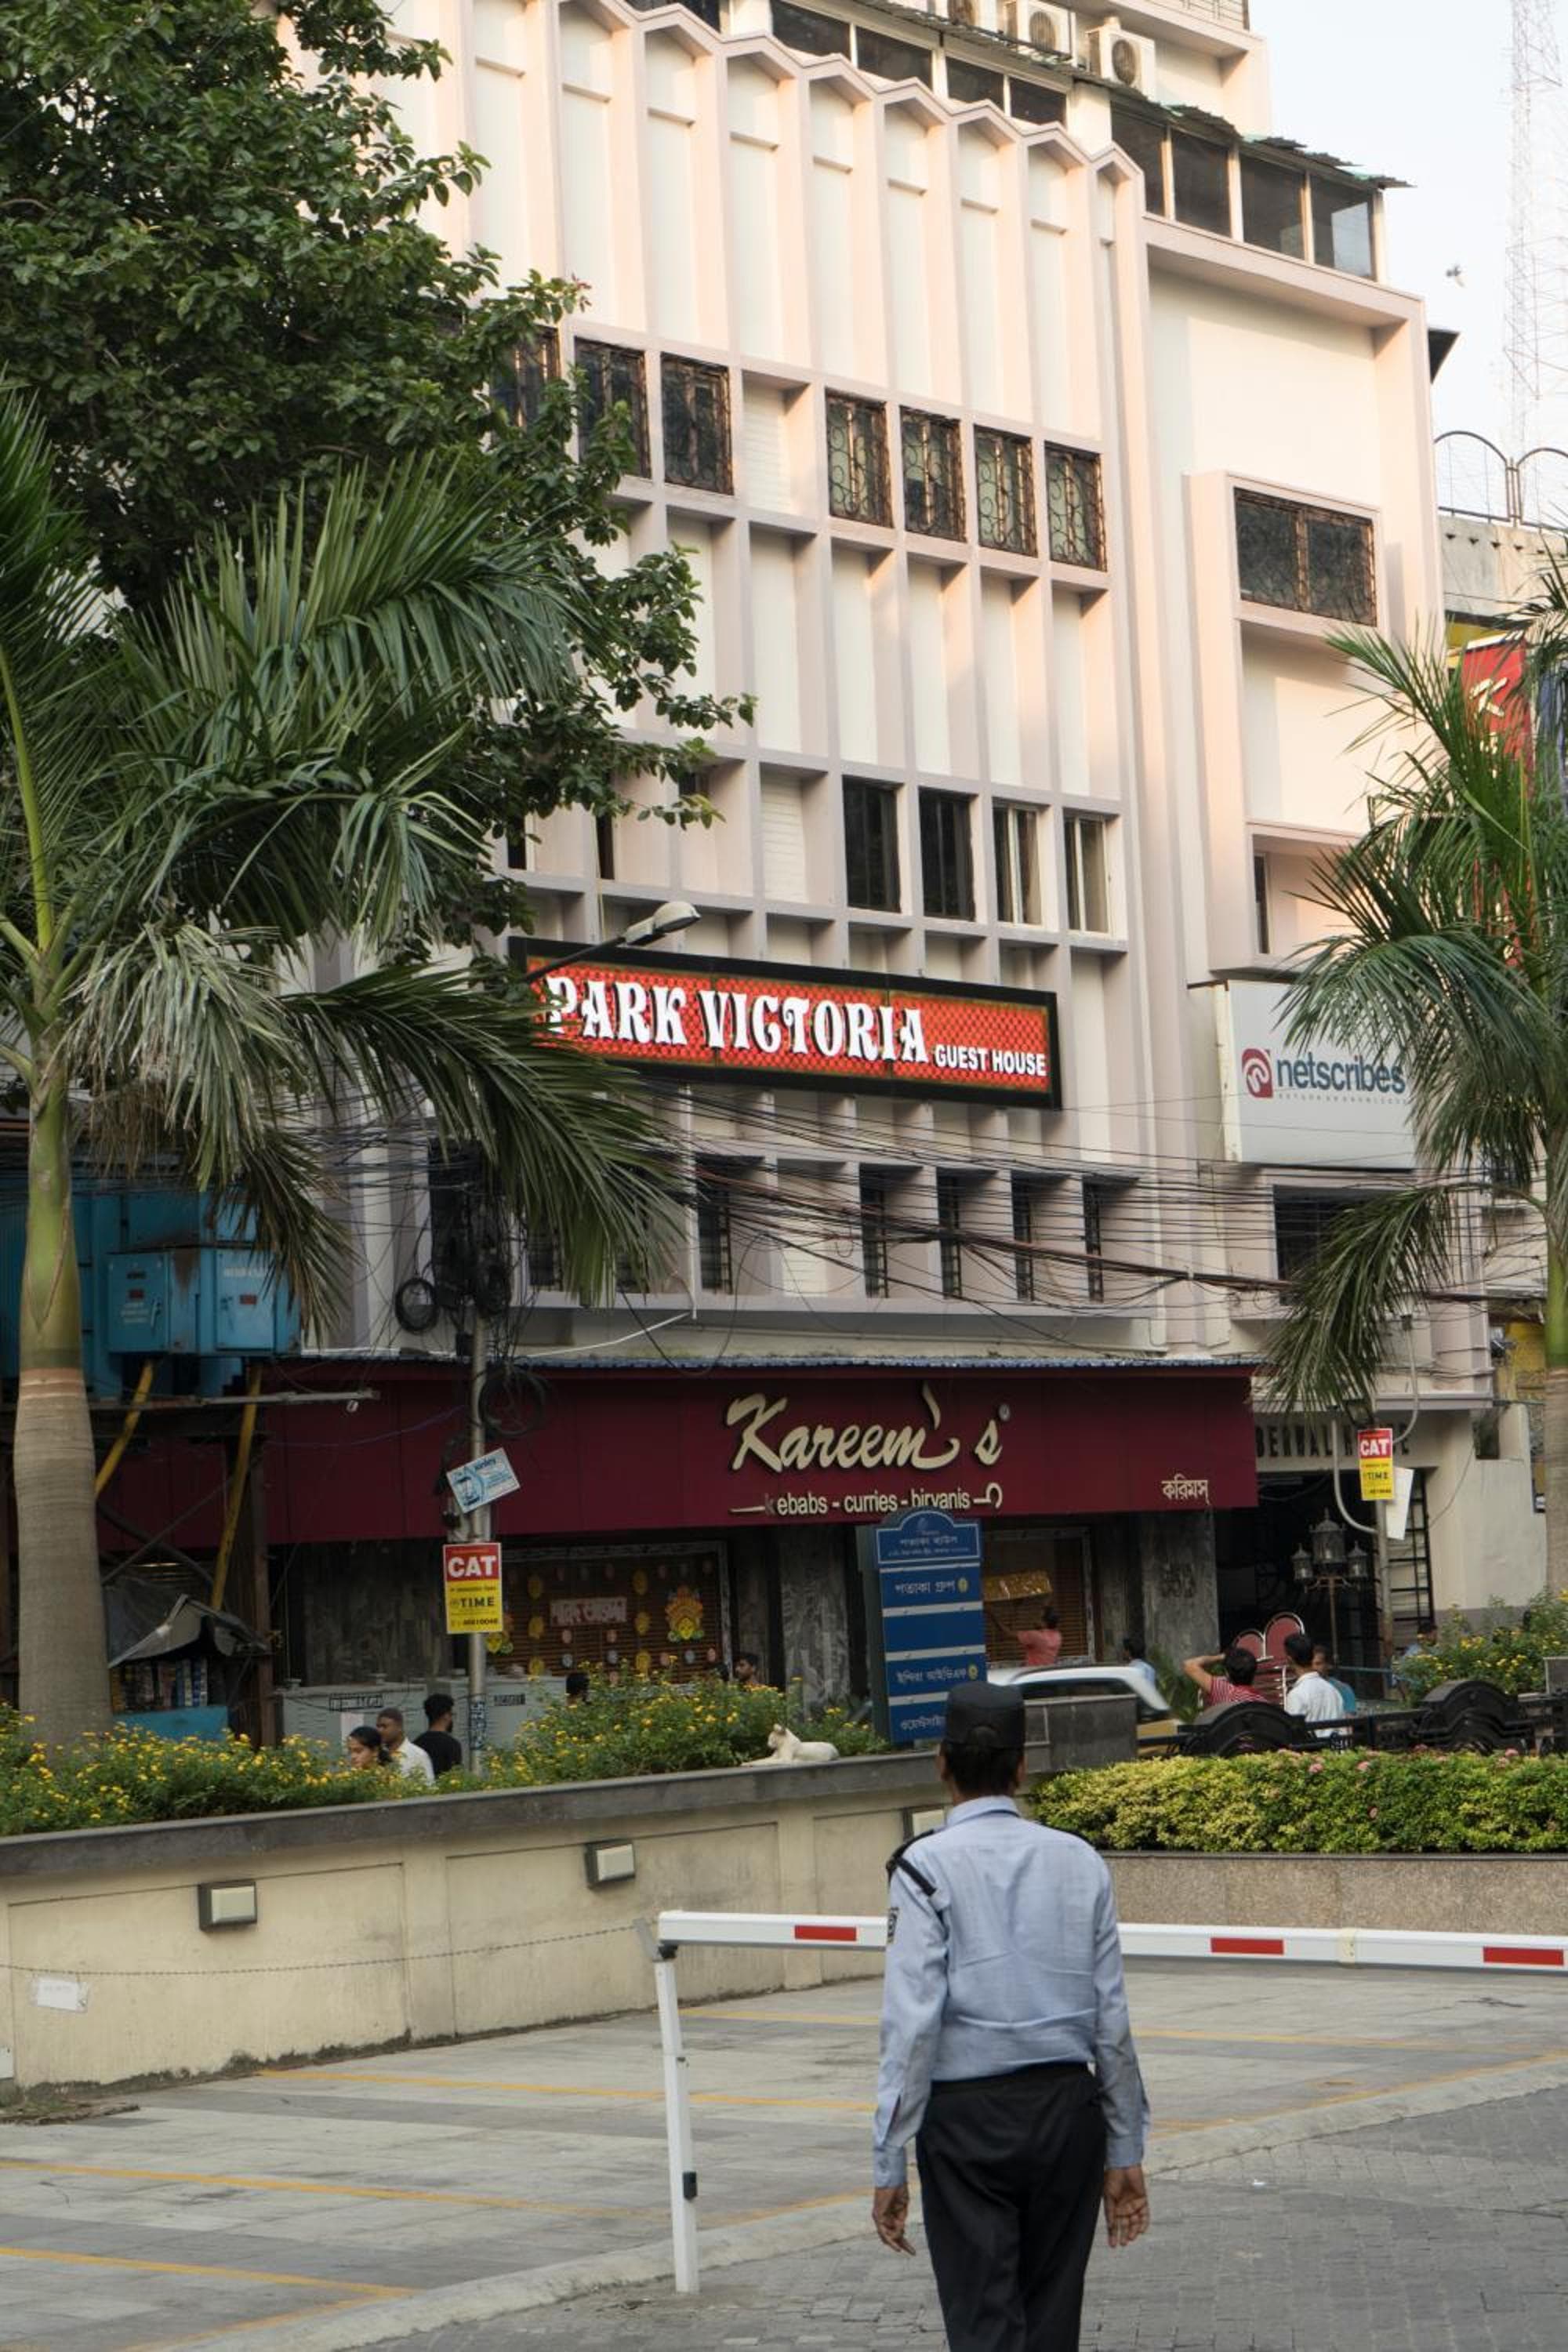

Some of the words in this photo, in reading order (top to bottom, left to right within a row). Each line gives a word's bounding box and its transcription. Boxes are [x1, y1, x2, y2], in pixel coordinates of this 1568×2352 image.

[546, 975, 688, 1046] PARK
[696, 991, 930, 1063] VICTORIA
[934, 1046, 989, 1071] GUEST
[992, 1051, 1047, 1076] HOUSE
[1276, 1052, 1406, 1094] netscribes
[726, 1385, 1004, 1472] Kareem's
[1360, 1438, 1390, 1456] CAT
[844, 1489, 898, 1513] curries
[448, 1555, 496, 1578] CAT
